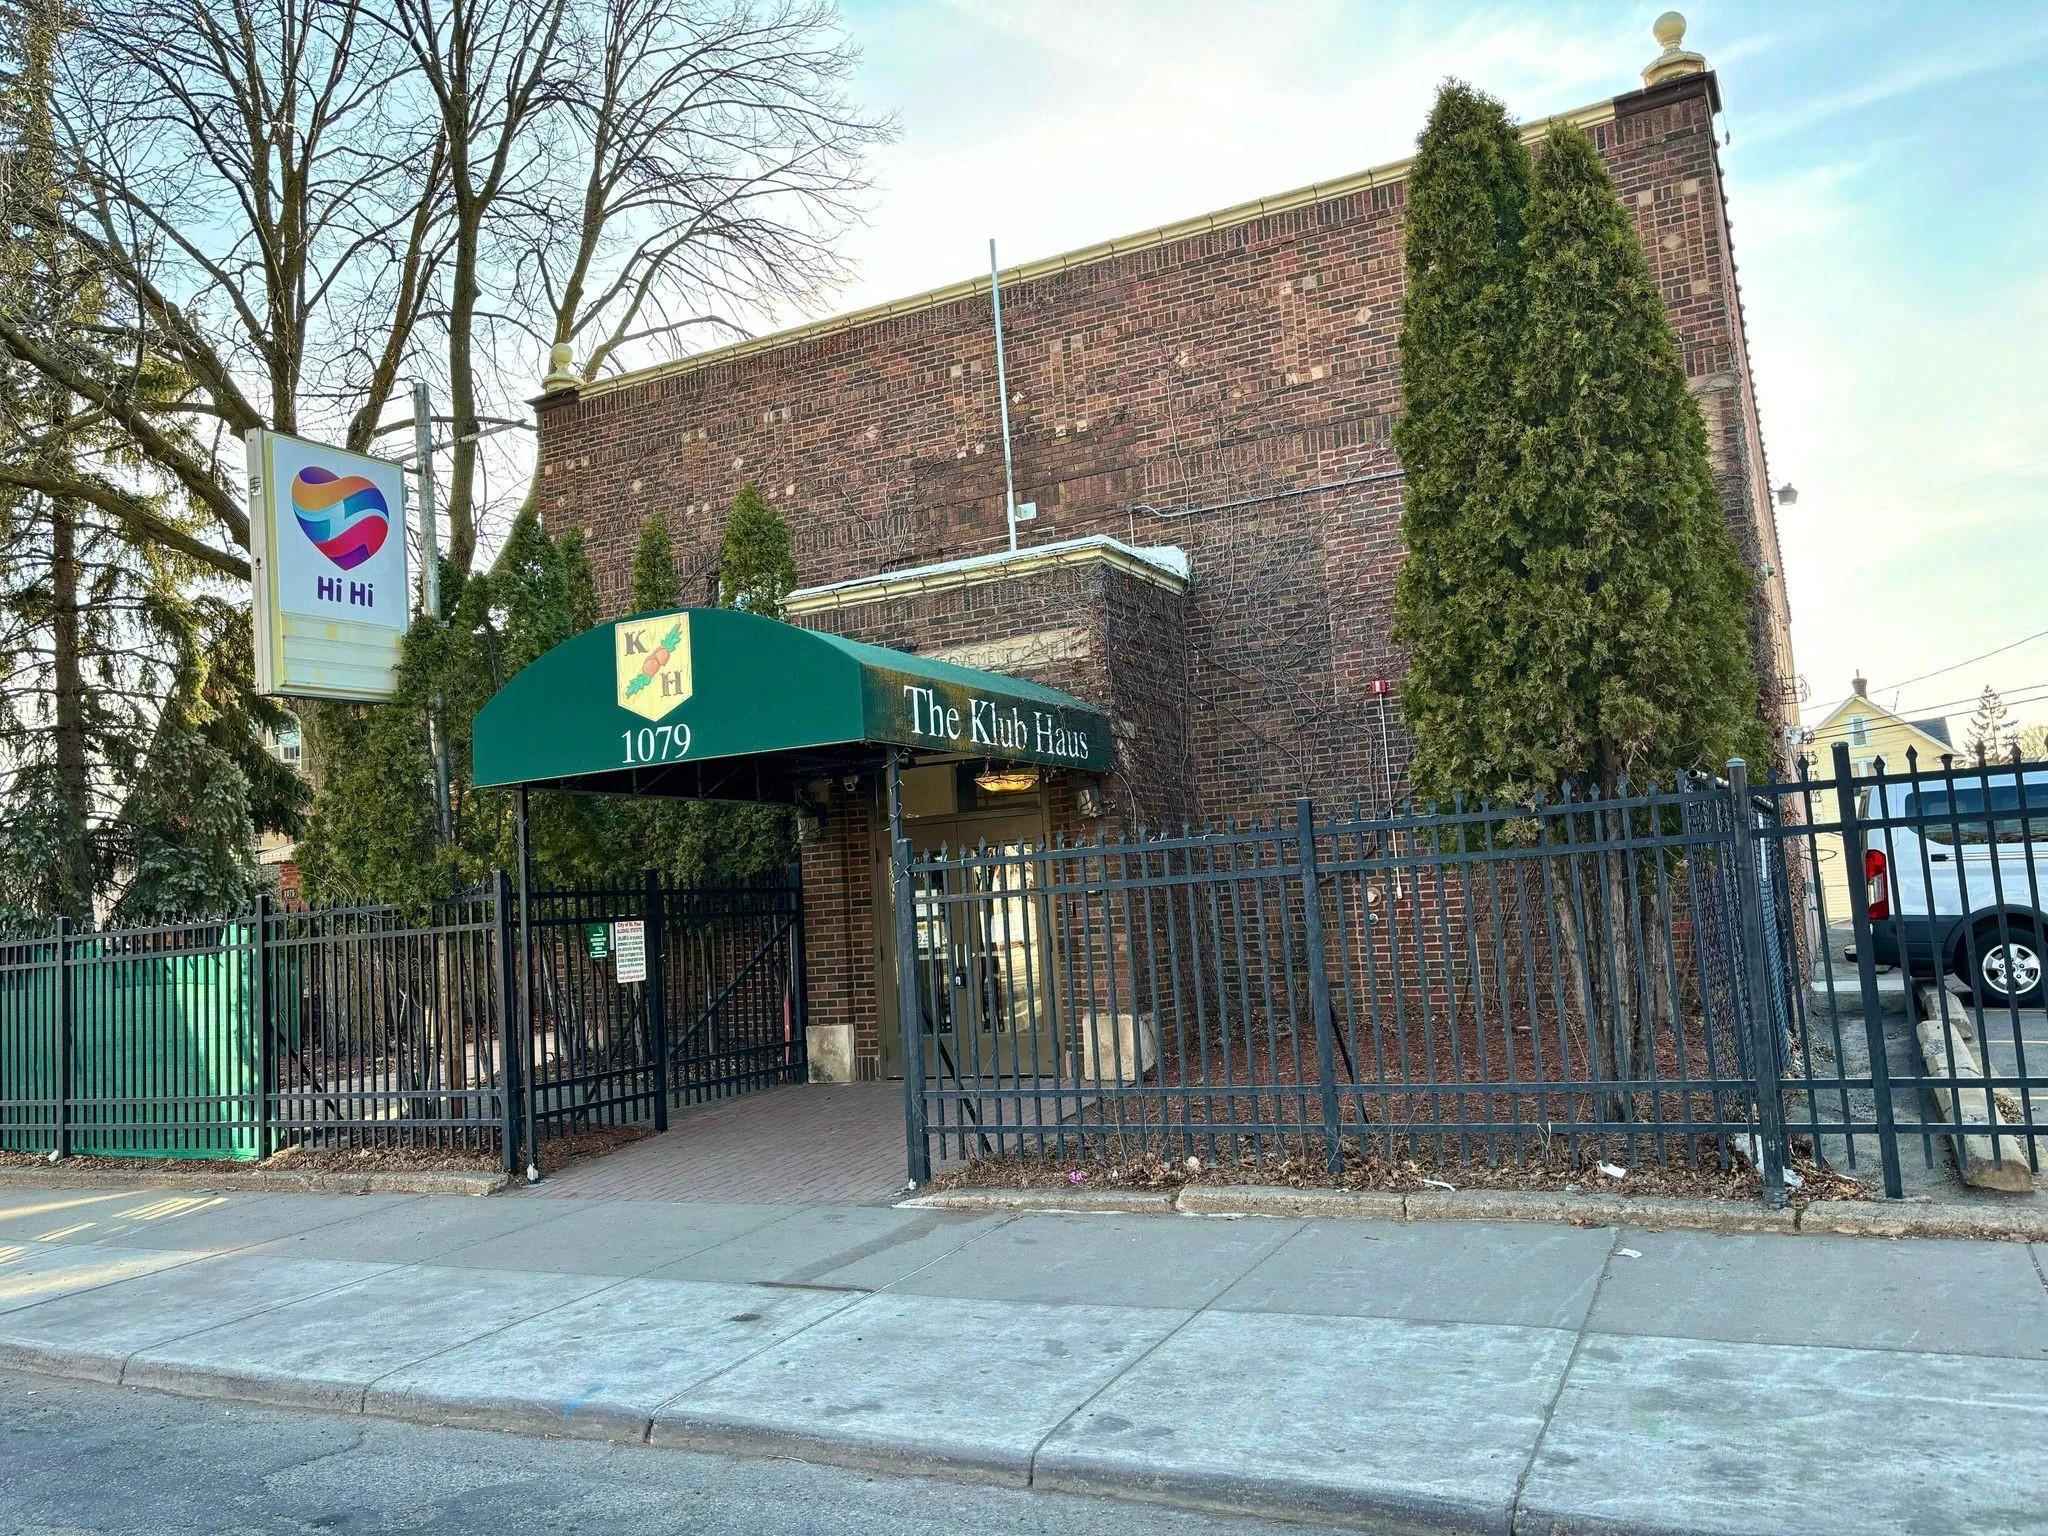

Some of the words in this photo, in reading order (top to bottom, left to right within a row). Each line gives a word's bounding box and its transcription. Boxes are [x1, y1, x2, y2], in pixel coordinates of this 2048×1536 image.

[317, 575, 343, 602] Hi
[350, 581, 374, 607] Hi
[624, 629, 649, 656] K
[660, 669, 684, 697] H
[904, 685, 962, 740] The
[968, 698, 1028, 750] Klub
[1033, 711, 1090, 760] Haus
[622, 723, 691, 764] 1079
